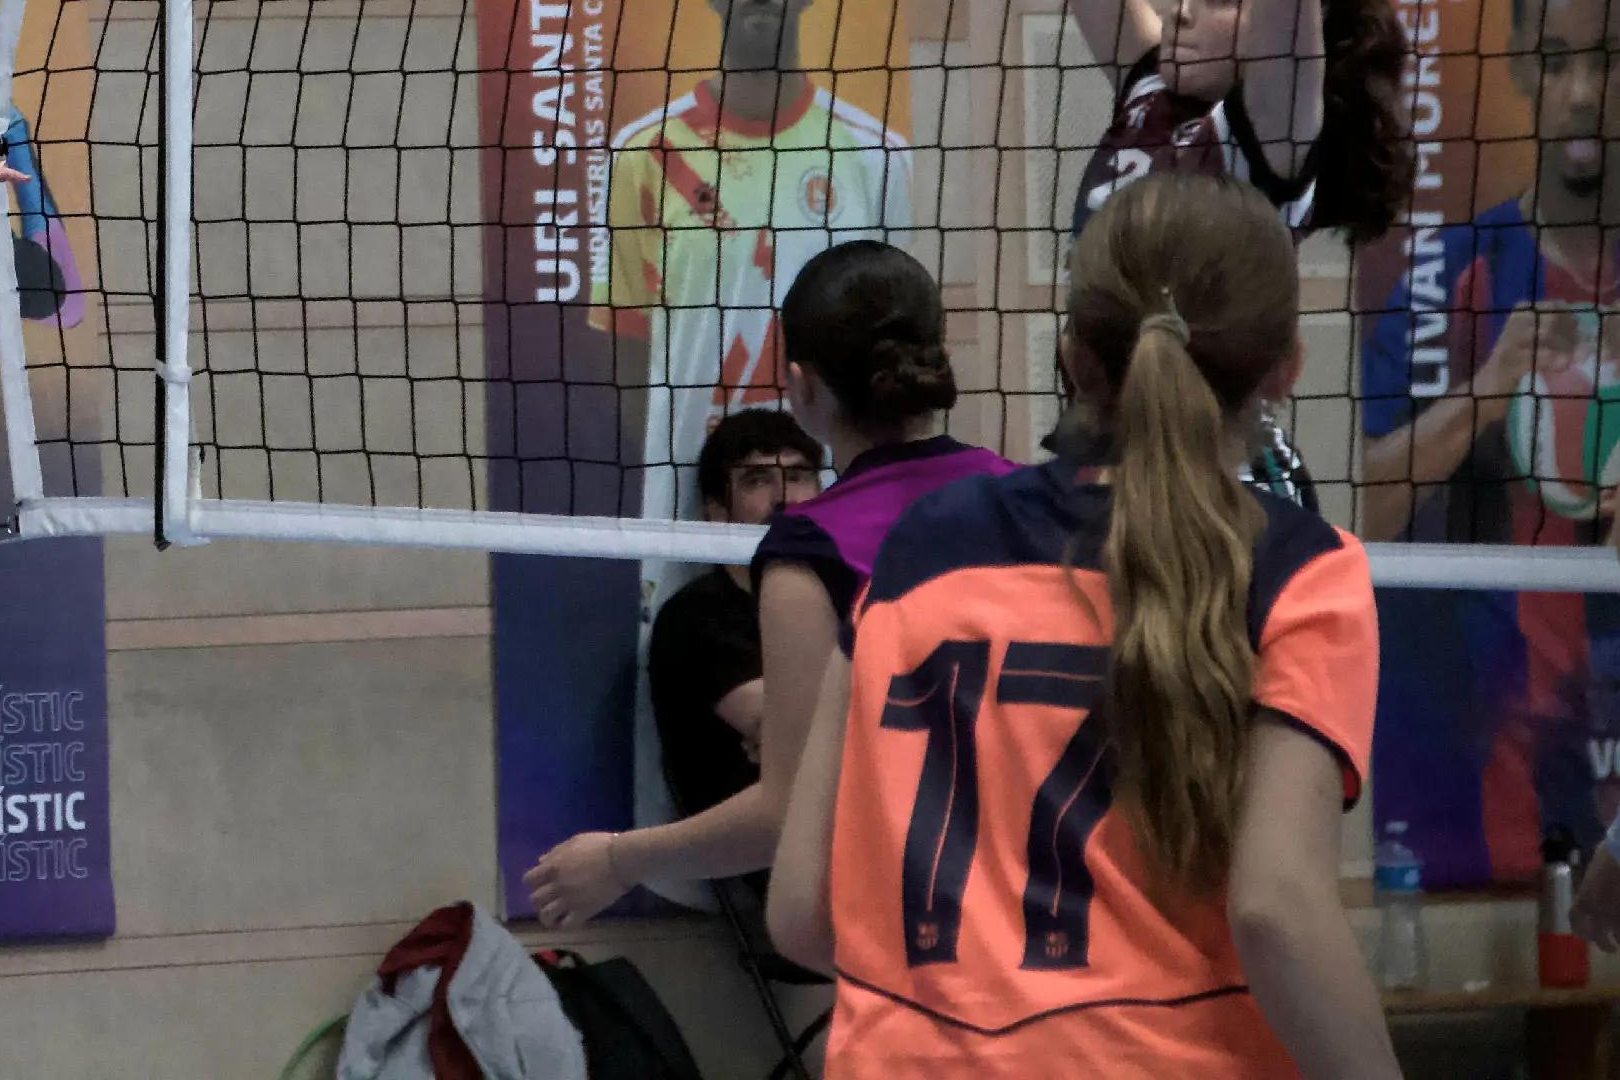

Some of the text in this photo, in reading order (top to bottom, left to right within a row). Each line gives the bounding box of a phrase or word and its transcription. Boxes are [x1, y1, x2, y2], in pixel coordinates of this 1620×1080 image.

[583, 24, 605, 111] SANTA
[534, 189, 580, 302] URI
[880, 639, 1116, 970] 17
